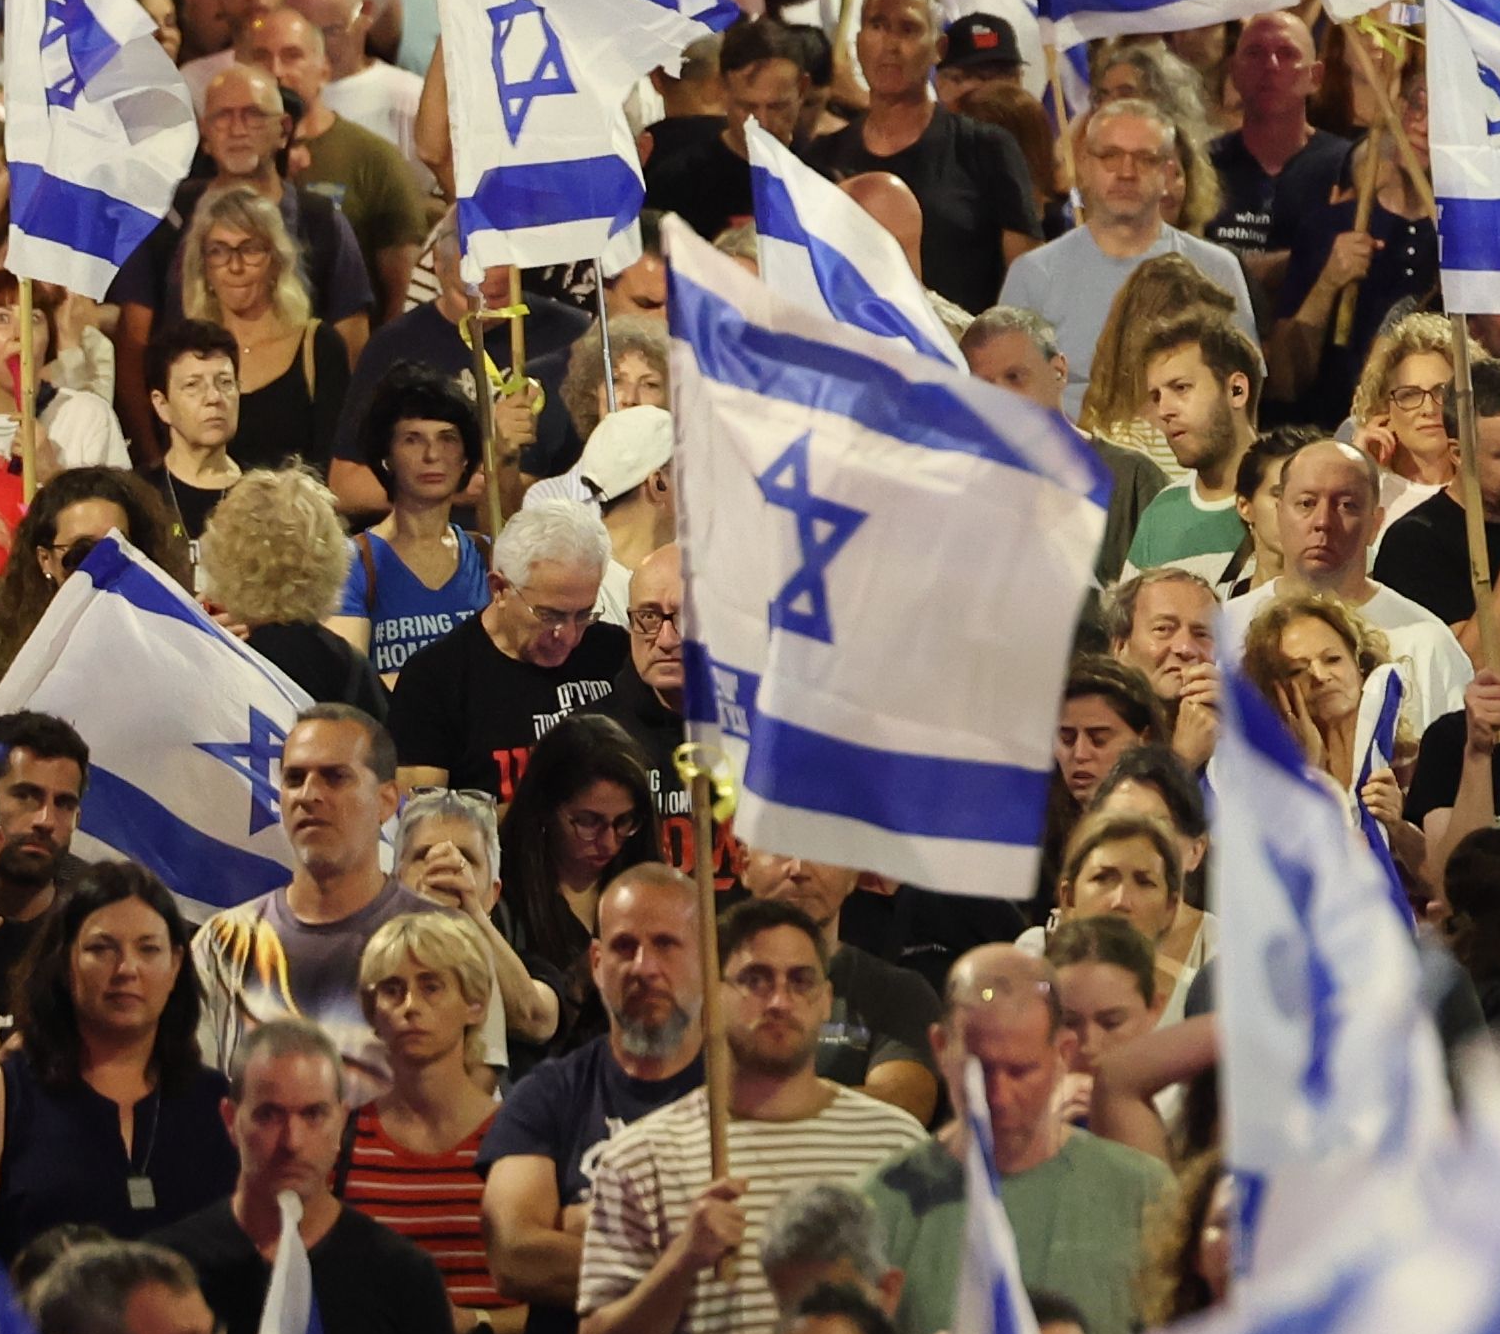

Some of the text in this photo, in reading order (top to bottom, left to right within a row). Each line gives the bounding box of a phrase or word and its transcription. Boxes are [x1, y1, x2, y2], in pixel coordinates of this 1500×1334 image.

[1235, 211, 1270, 224] when
[1217, 226, 1267, 244] nothing
[375, 613, 454, 644] #BRING
